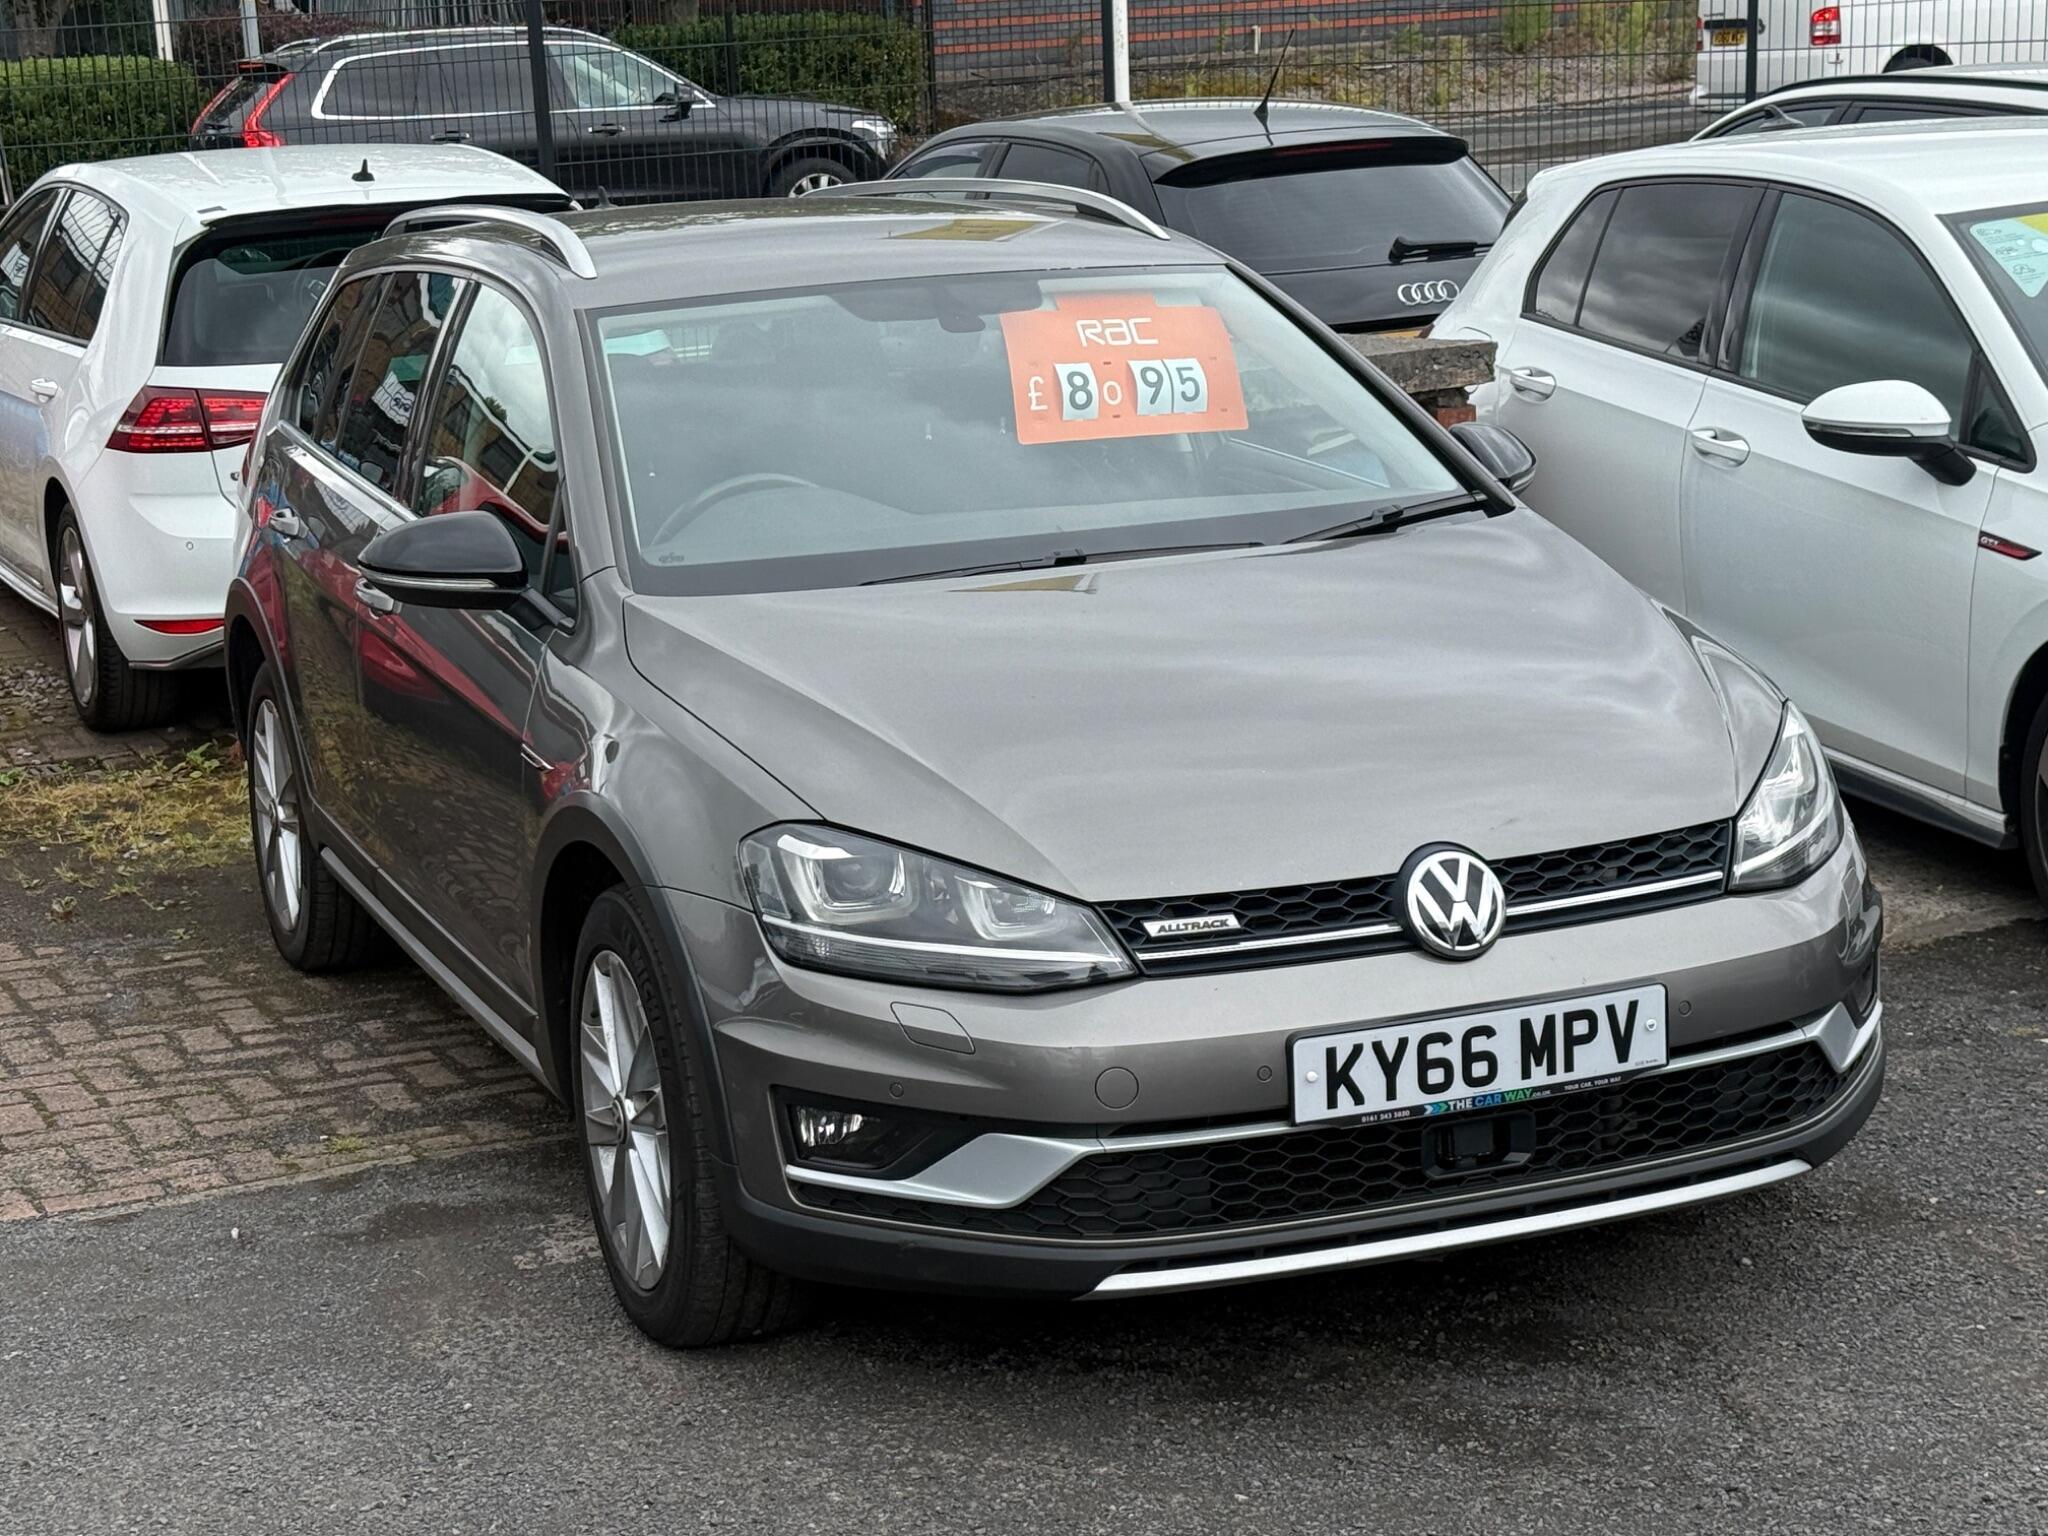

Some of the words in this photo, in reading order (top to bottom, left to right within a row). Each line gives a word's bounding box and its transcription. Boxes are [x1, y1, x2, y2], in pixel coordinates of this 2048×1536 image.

[1157, 918, 1229, 933] ALLTRACK
[1325, 1024, 1499, 1110] KY66
[1519, 999, 1640, 1081] MPV
